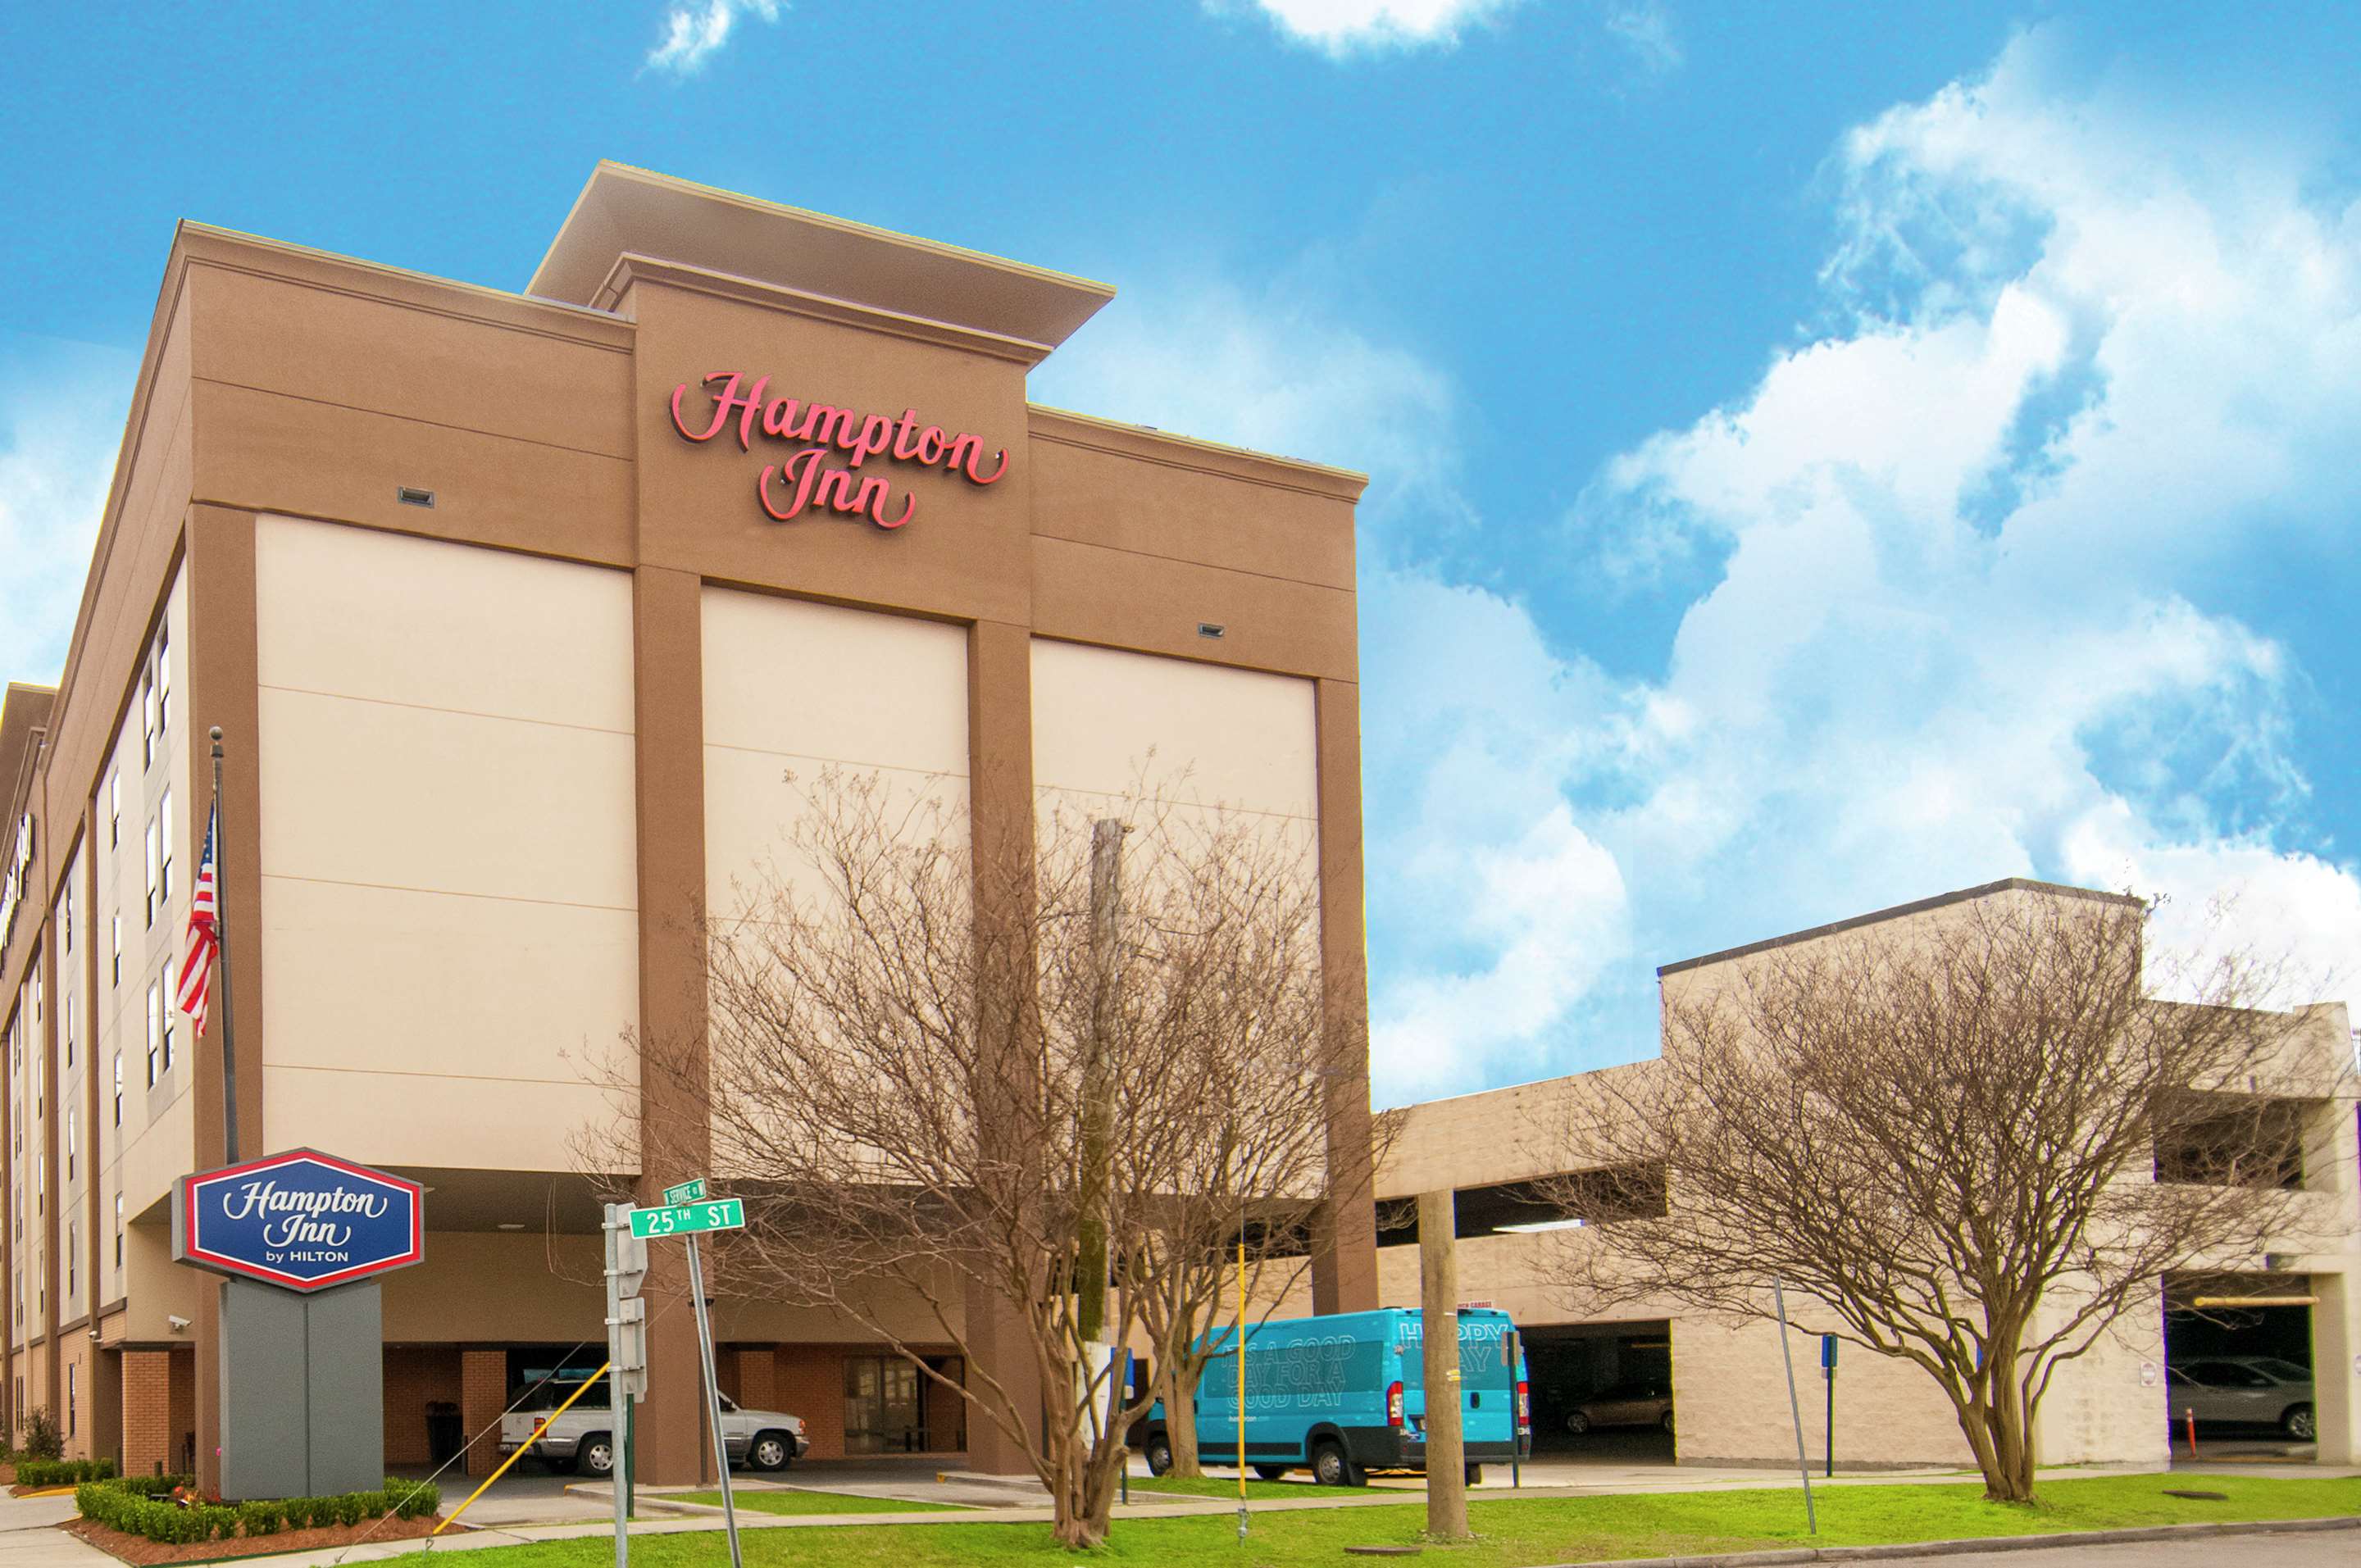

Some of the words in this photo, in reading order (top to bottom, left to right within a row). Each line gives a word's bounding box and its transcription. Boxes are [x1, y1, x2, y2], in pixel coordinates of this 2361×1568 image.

[670, 370, 1010, 486] Hampton
[758, 448, 917, 529] Inn
[223, 1180, 388, 1220] Hampton
[263, 1213, 352, 1248] Inn
[646, 1210, 691, 1234] 25TH
[707, 1204, 730, 1226] ST
[266, 1251, 284, 1263] by
[290, 1251, 348, 1262] HILTON
[1286, 1334, 1356, 1362] GOOD
[1399, 1322, 1508, 1349] HPPY
[1276, 1361, 1321, 1386] FOR
[1326, 1357, 1346, 1384] A
[1298, 1382, 1346, 1407] DAY
